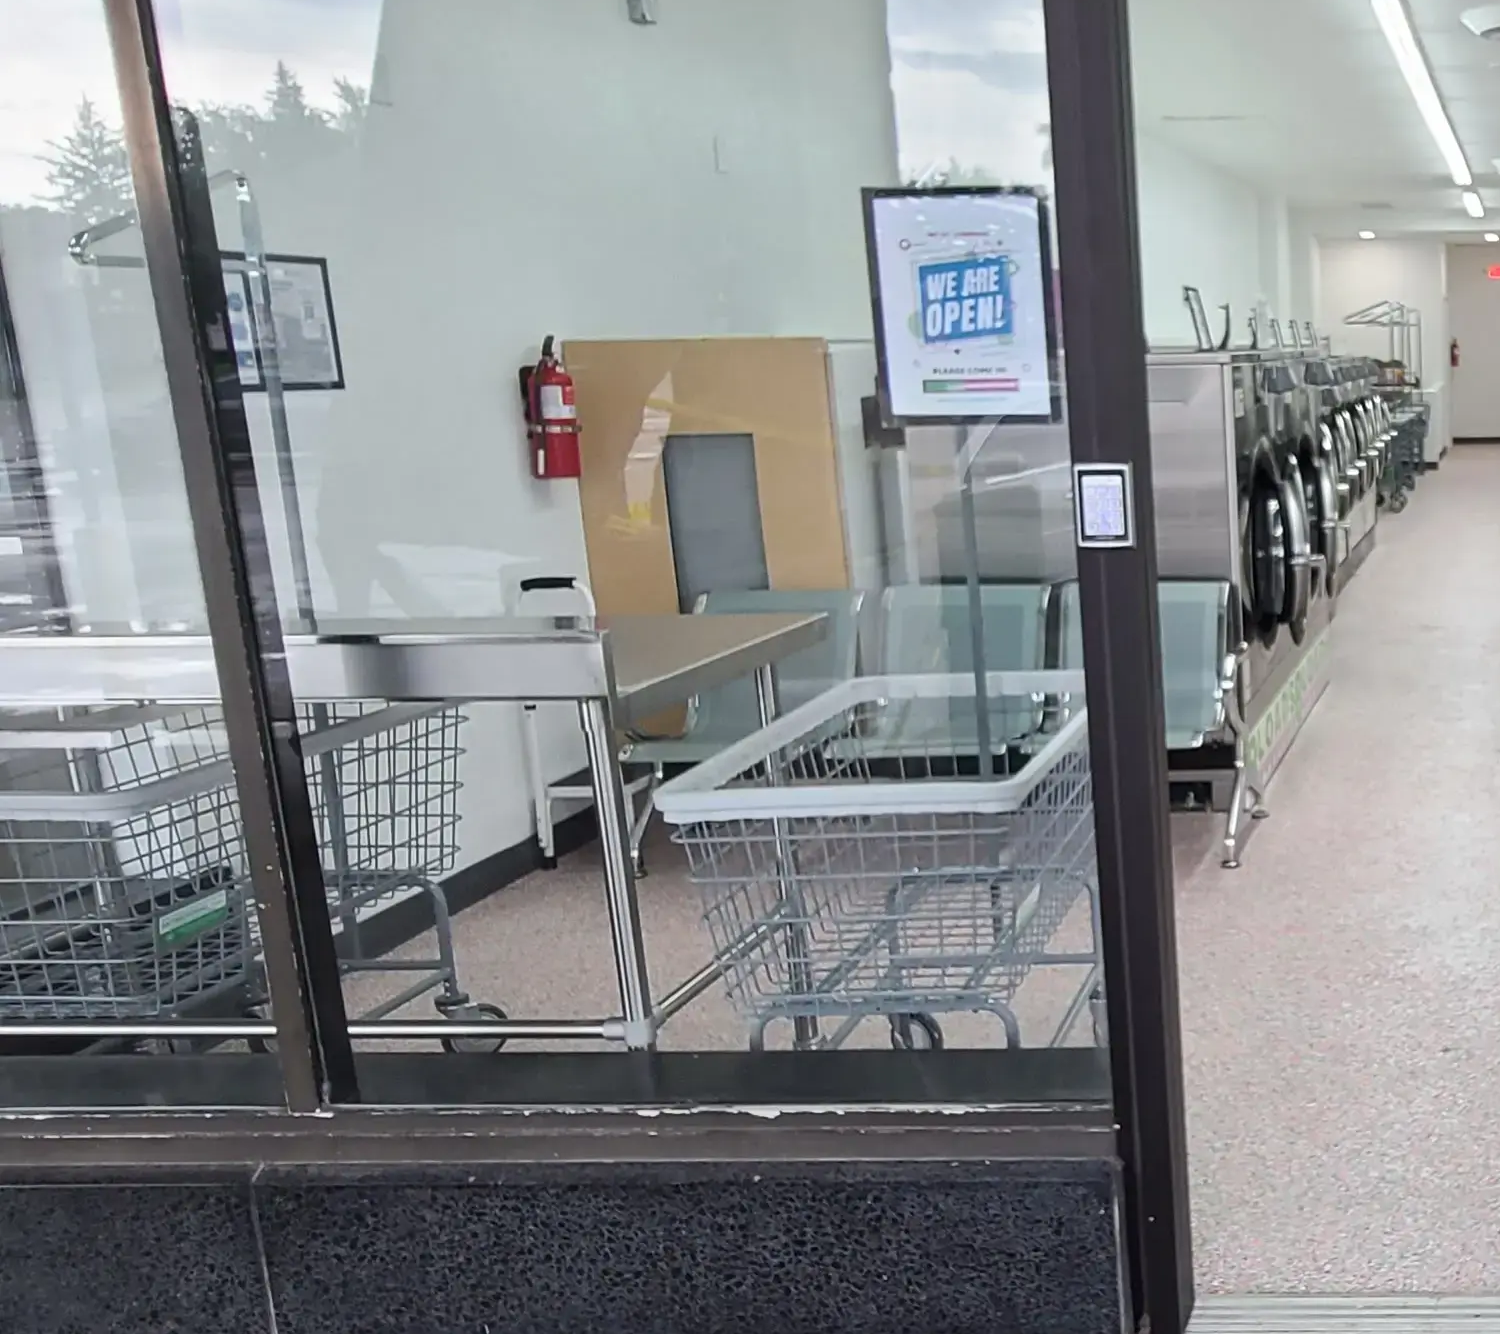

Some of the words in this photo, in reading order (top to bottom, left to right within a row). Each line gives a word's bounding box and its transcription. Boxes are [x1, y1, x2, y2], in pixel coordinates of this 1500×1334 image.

[926, 270, 958, 300] WE
[961, 265, 1000, 297] ARE
[926, 295, 1006, 337] OPEN!
